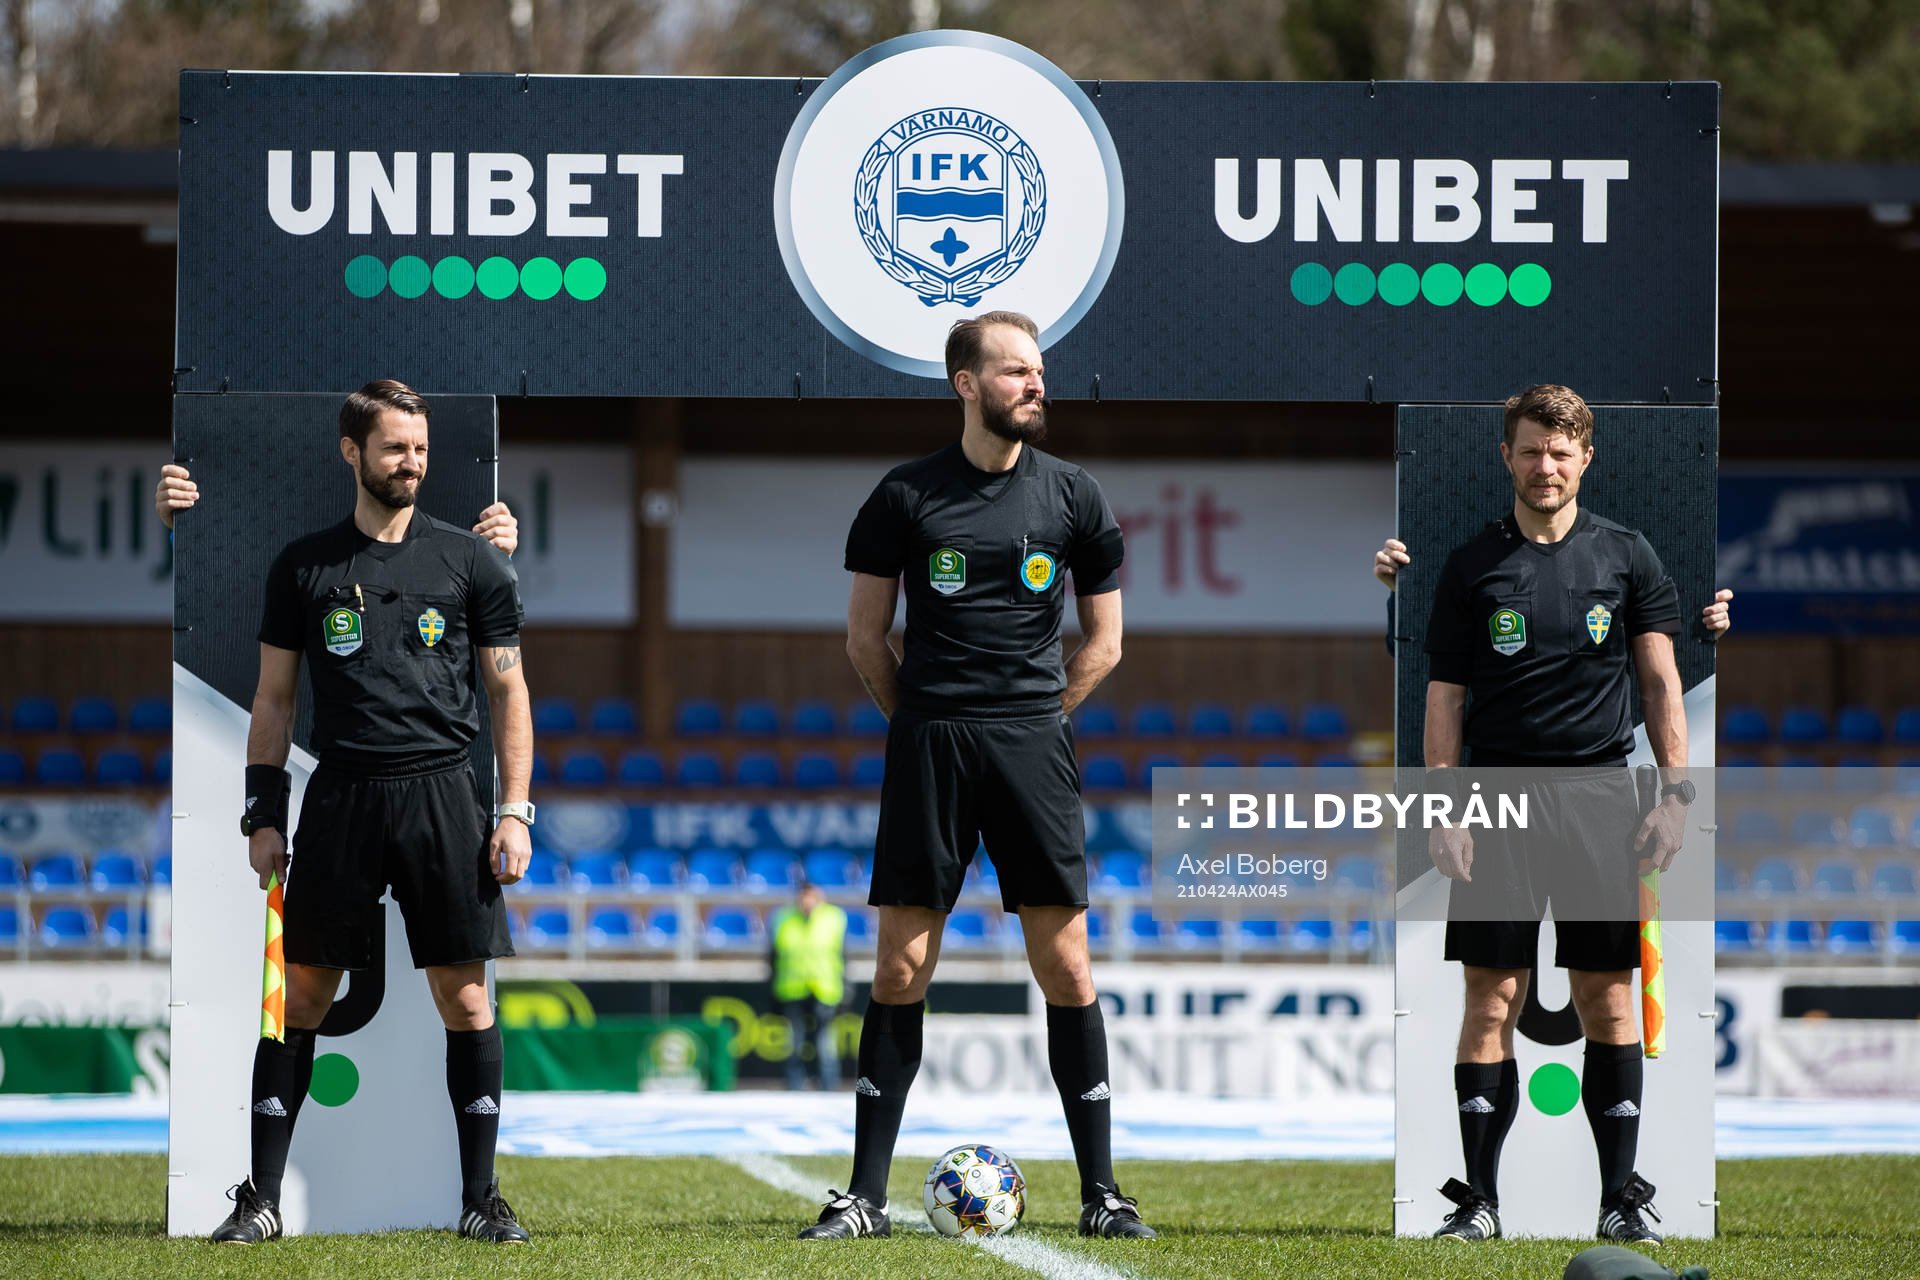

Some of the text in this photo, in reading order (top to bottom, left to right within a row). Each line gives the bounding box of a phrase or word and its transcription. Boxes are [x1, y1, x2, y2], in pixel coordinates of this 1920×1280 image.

[890, 110, 1009, 143] VÄRNAMO
[912, 153, 989, 181] IFK
[268, 150, 684, 238] UNIBET
[1214, 158, 1629, 244] UNIBET
[253, 1103, 287, 1117] adidas
[464, 1104, 499, 1115] adidas
